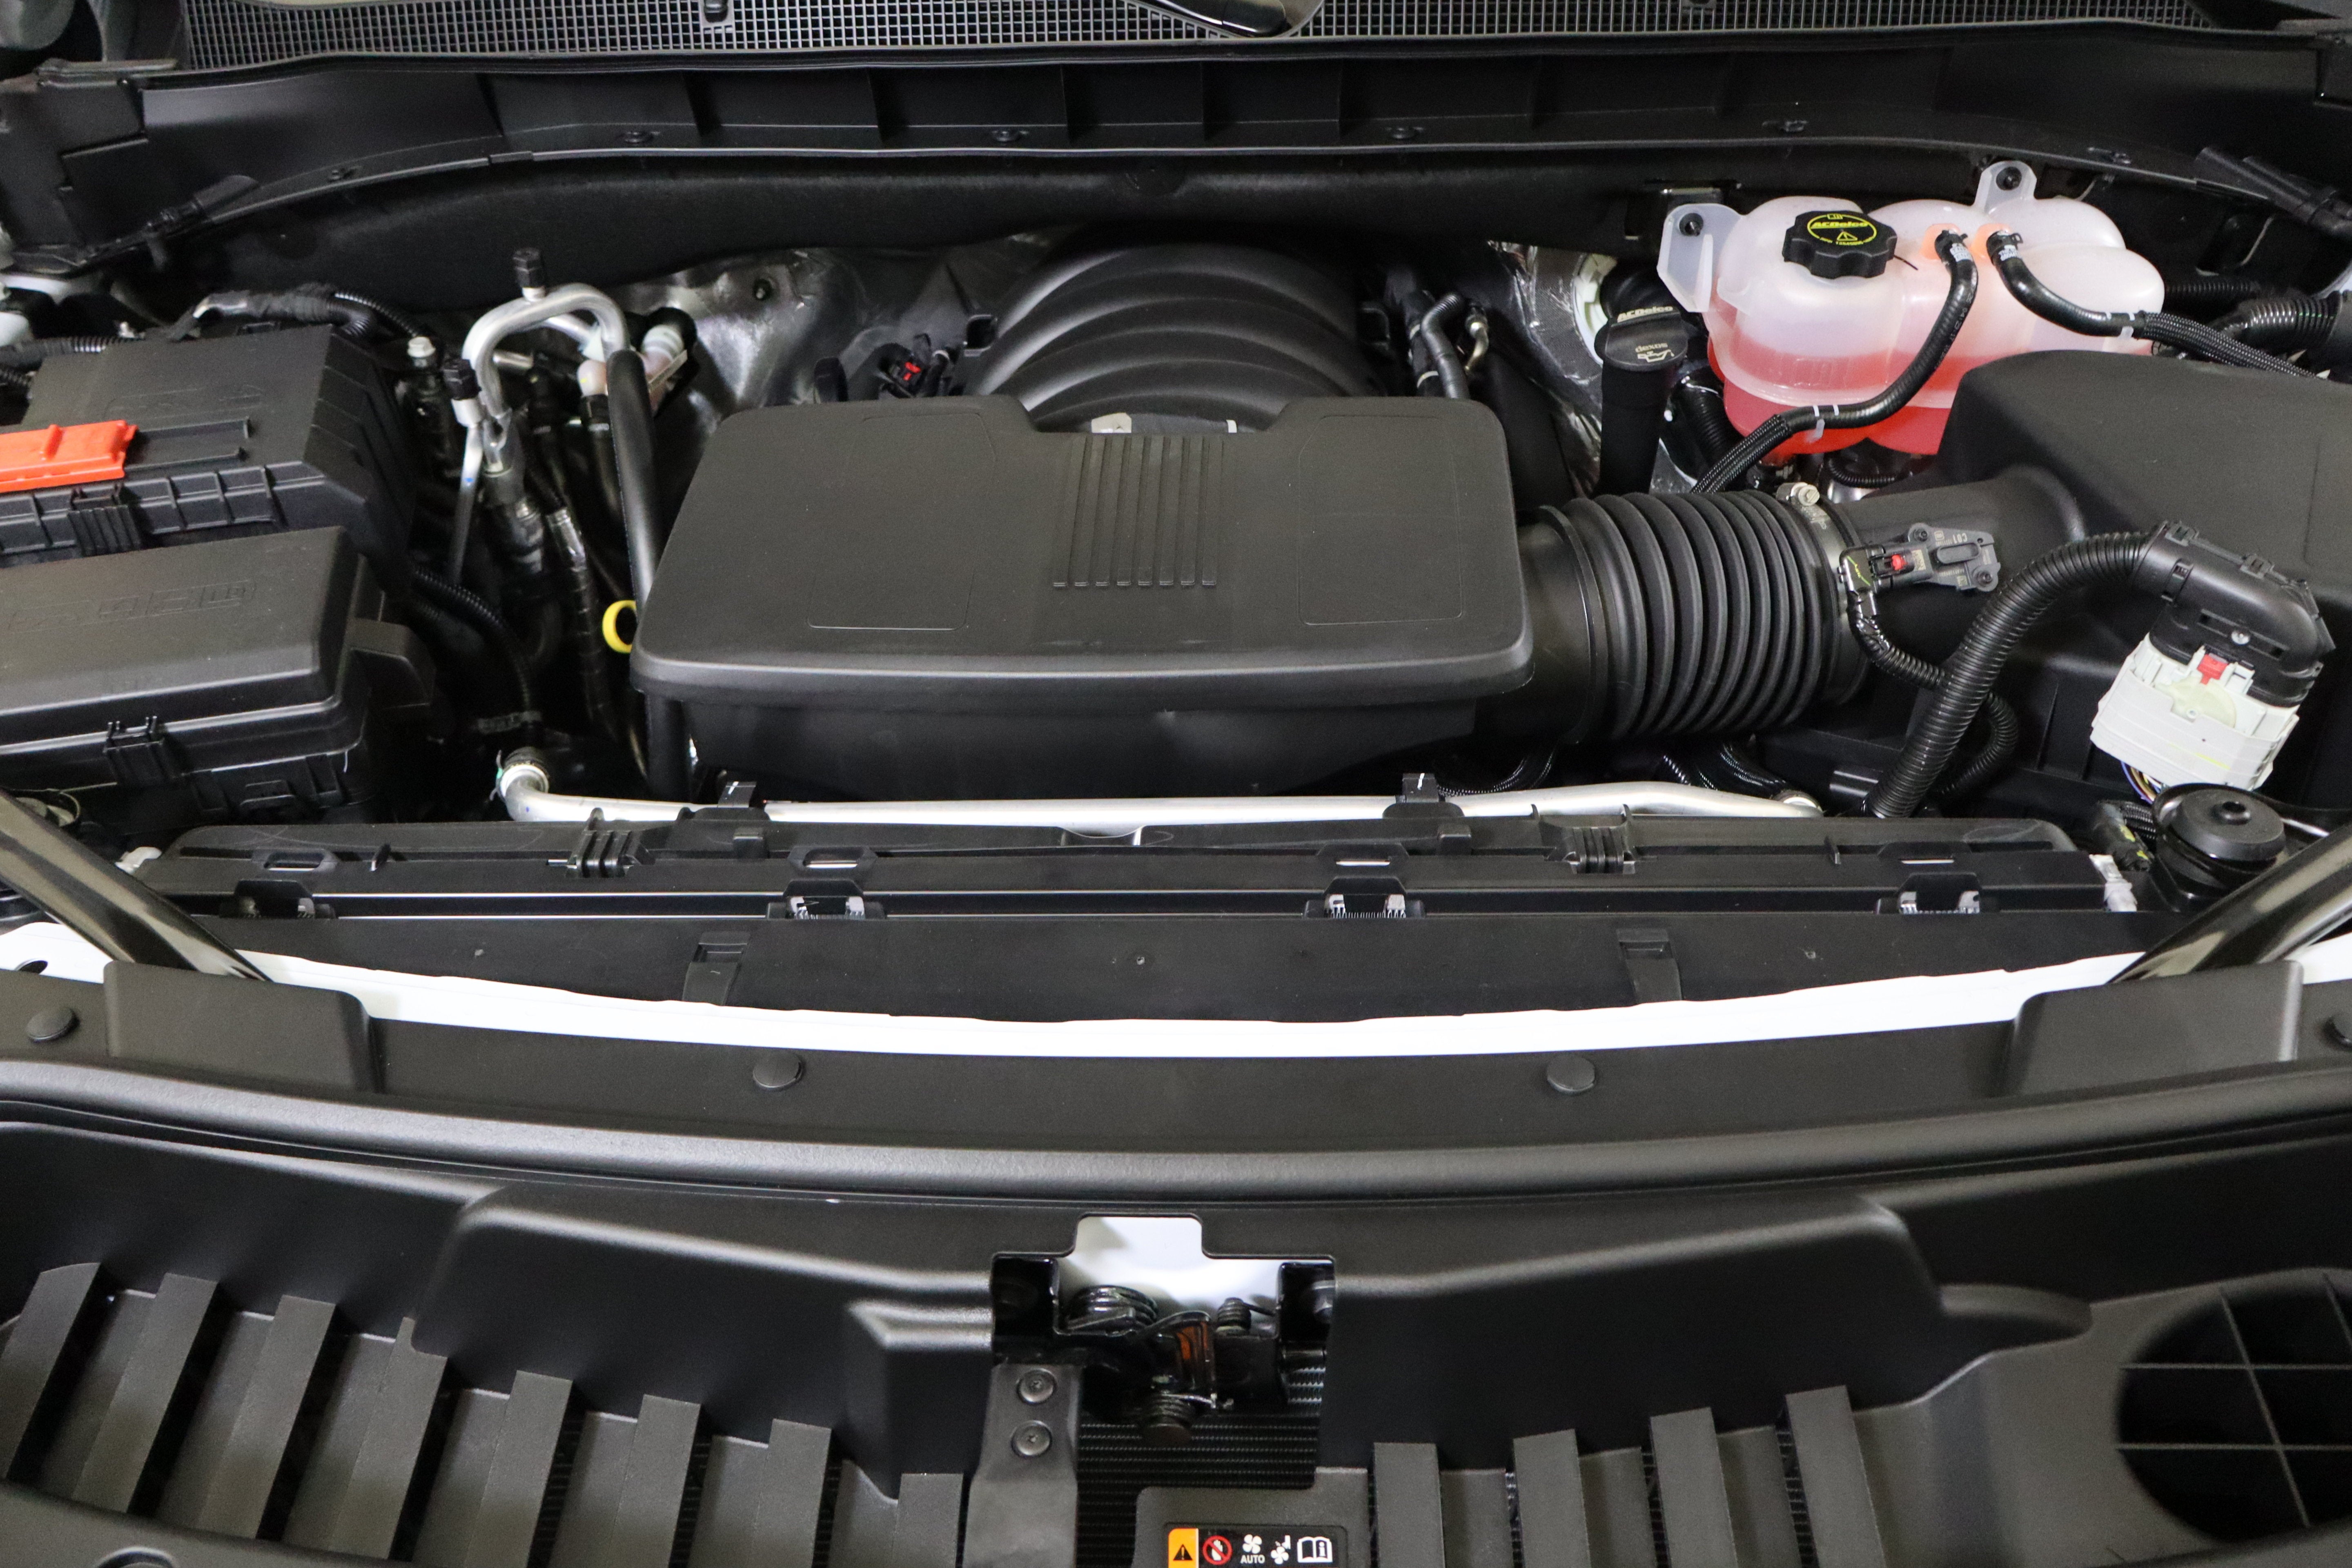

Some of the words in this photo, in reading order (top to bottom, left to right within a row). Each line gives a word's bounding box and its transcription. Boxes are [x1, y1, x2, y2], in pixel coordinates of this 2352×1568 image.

[1617, 306, 1673, 323] ACDelco
[1635, 343, 1668, 353] dexos
[1240, 1554, 1265, 1564] AUTO
